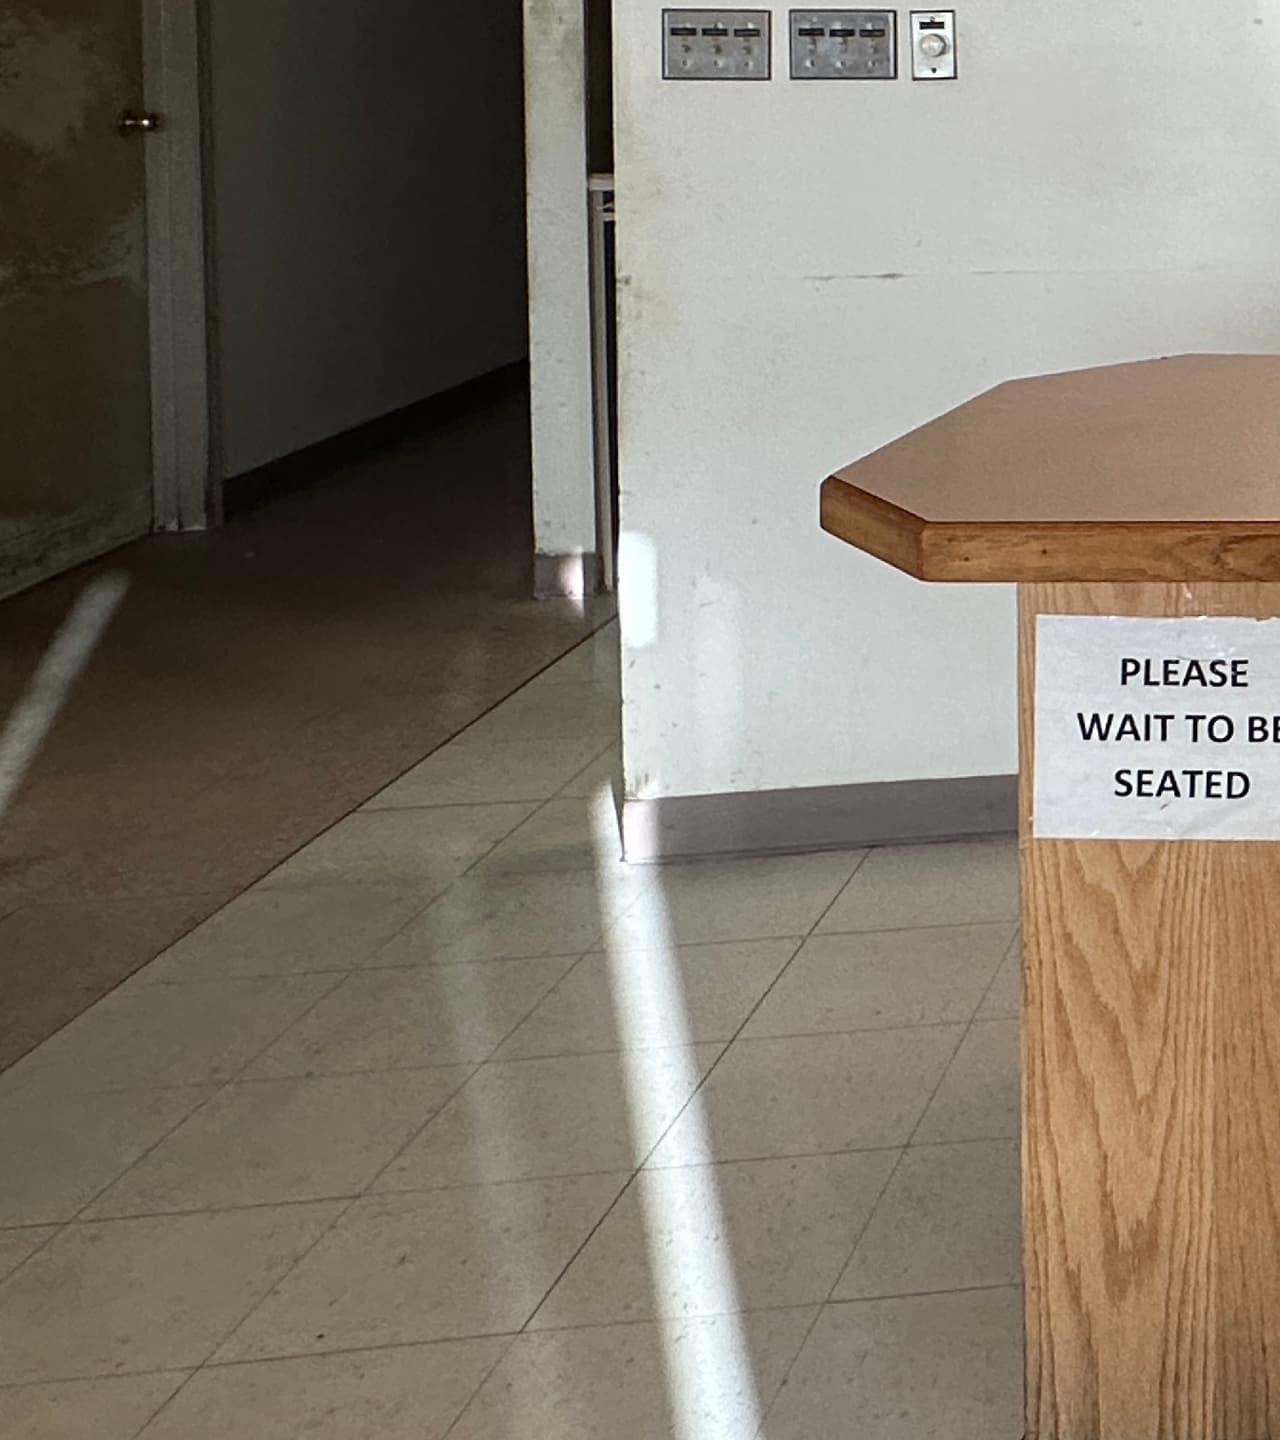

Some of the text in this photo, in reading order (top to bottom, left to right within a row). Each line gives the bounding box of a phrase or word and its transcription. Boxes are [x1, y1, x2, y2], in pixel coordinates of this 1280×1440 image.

[1120, 658, 1250, 688] PLEASE
[1077, 712, 1175, 743] WAIT
[1184, 714, 1235, 744] TO
[1113, 768, 1251, 800] SEATED
